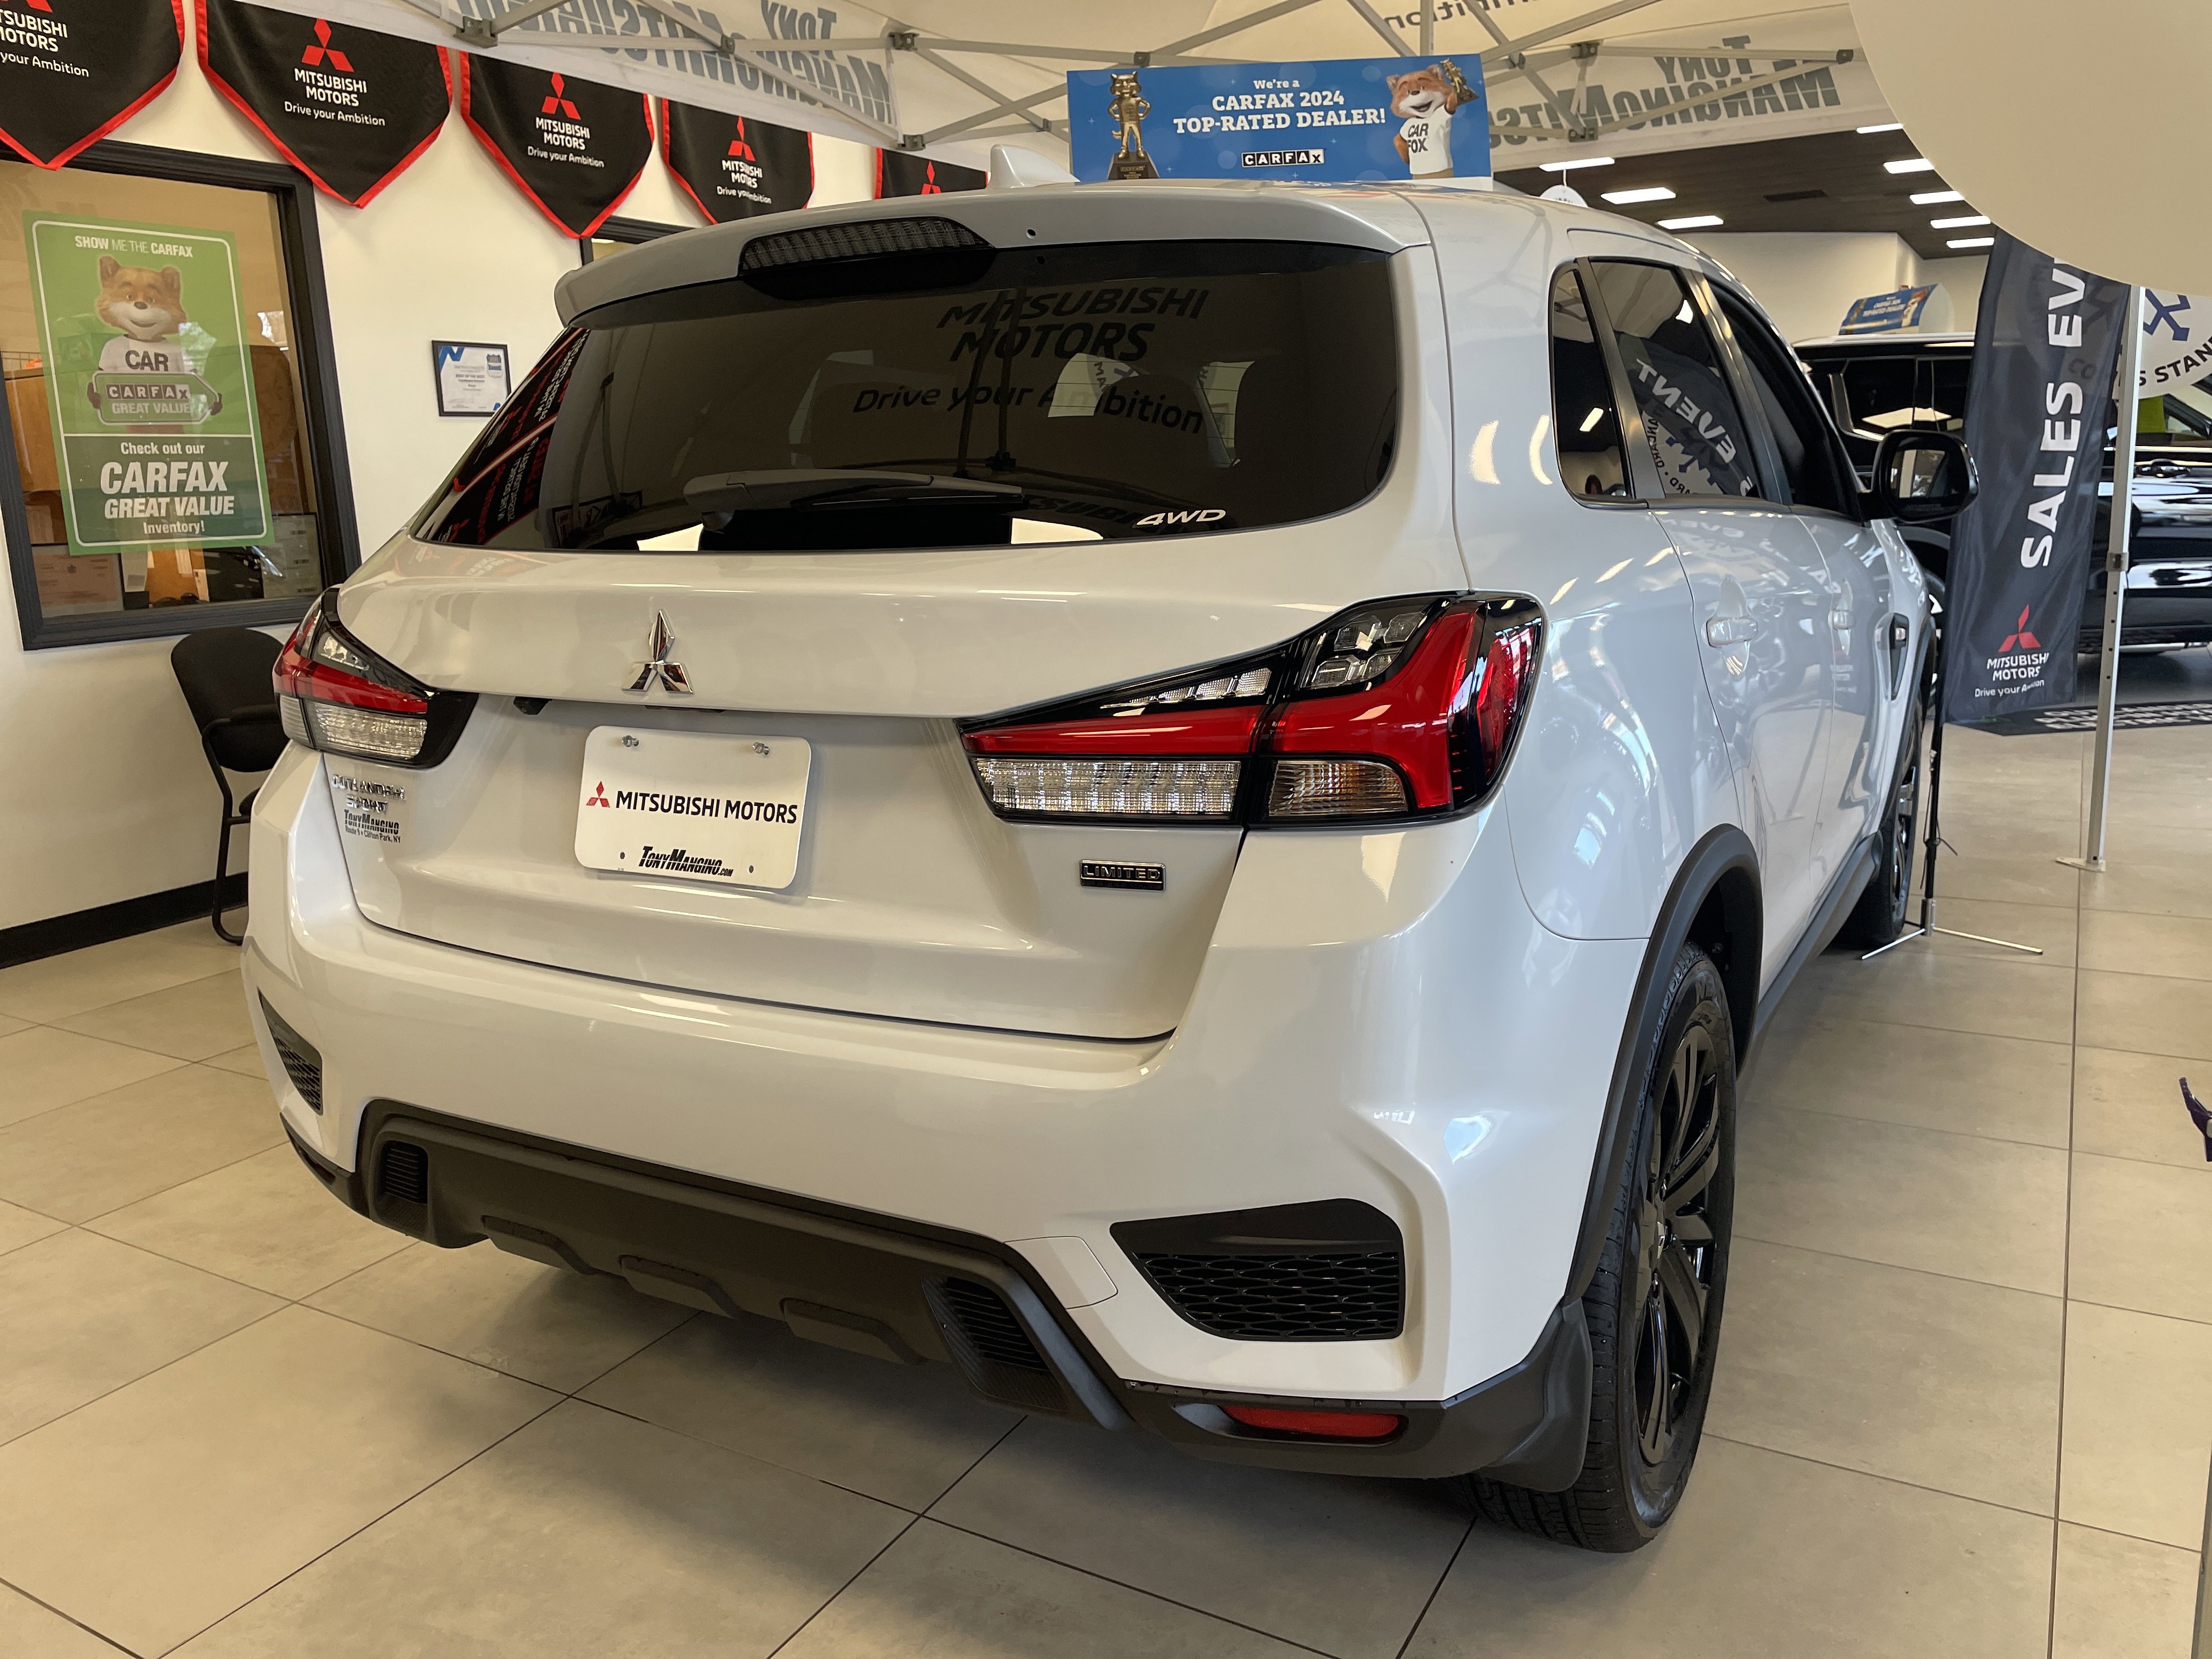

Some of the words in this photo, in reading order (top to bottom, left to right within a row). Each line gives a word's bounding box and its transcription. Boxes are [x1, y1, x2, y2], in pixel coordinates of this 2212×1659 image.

[0, 52, 30, 65] your
[32, 55, 89, 77] Ambition
[294, 68, 367, 93] MITSUBISHI
[1253, 80, 1289, 89] We're
[1292, 80, 1300, 88] a
[306, 86, 359, 106] MOTORS
[1212, 92, 1295, 111] CARFAX
[1299, 90, 1345, 107] 2024
[284, 101, 312, 115] Drive
[313, 109, 335, 119] your
[337, 111, 385, 126] Ambition
[1173, 112, 1291, 133] TOP-RATED
[1296, 108, 1386, 128] DEALER!
[535, 116, 590, 139] MITSUBISHI
[1408, 123, 1429, 138] CAR
[544, 132, 585, 150] MOTORS
[1407, 138, 1428, 153] FOX
[527, 146, 548, 159] Drive
[549, 151, 567, 162] your
[568, 153, 605, 168] Ambition
[1244, 151, 1321, 165] CARFAX
[716, 186, 736, 196] Drive
[75, 235, 109, 250] SHOW
[112, 239, 128, 252] ME
[130, 240, 150, 253] THE
[150, 242, 193, 258] CARFAX
[2047, 257, 2085, 348] EV
[125, 350, 168, 371] CAR
[2154, 336, 2212, 383] STAN
[108, 386, 189, 399] CARFAX
[112, 402, 150, 414] GREAT
[153, 402, 191, 414] VALUE
[121, 442, 159, 454] Check
[162, 442, 182, 454] out
[185, 444, 205, 454] our
[100, 461, 229, 494] CARFAX
[2020, 382, 2084, 568] SALES
[105, 496, 170, 519] GREAT
[174, 496, 234, 516] VALUE
[143, 520, 205, 534] Inventory!
[1136, 509, 1226, 526] 4WD
[1987, 652, 2049, 670] MITSUBISHI
[1993, 666, 2041, 681] MOTORS
[1974, 687, 1996, 697] Drive
[1997, 686, 2021, 697] your
[616, 790, 720, 818] MITSUBISHI
[724, 799, 798, 825] MOTORS
[364, 830, 379, 839] Clifton
[393, 835, 401, 843] NY
[1083, 865, 1160, 880] LIMITED
